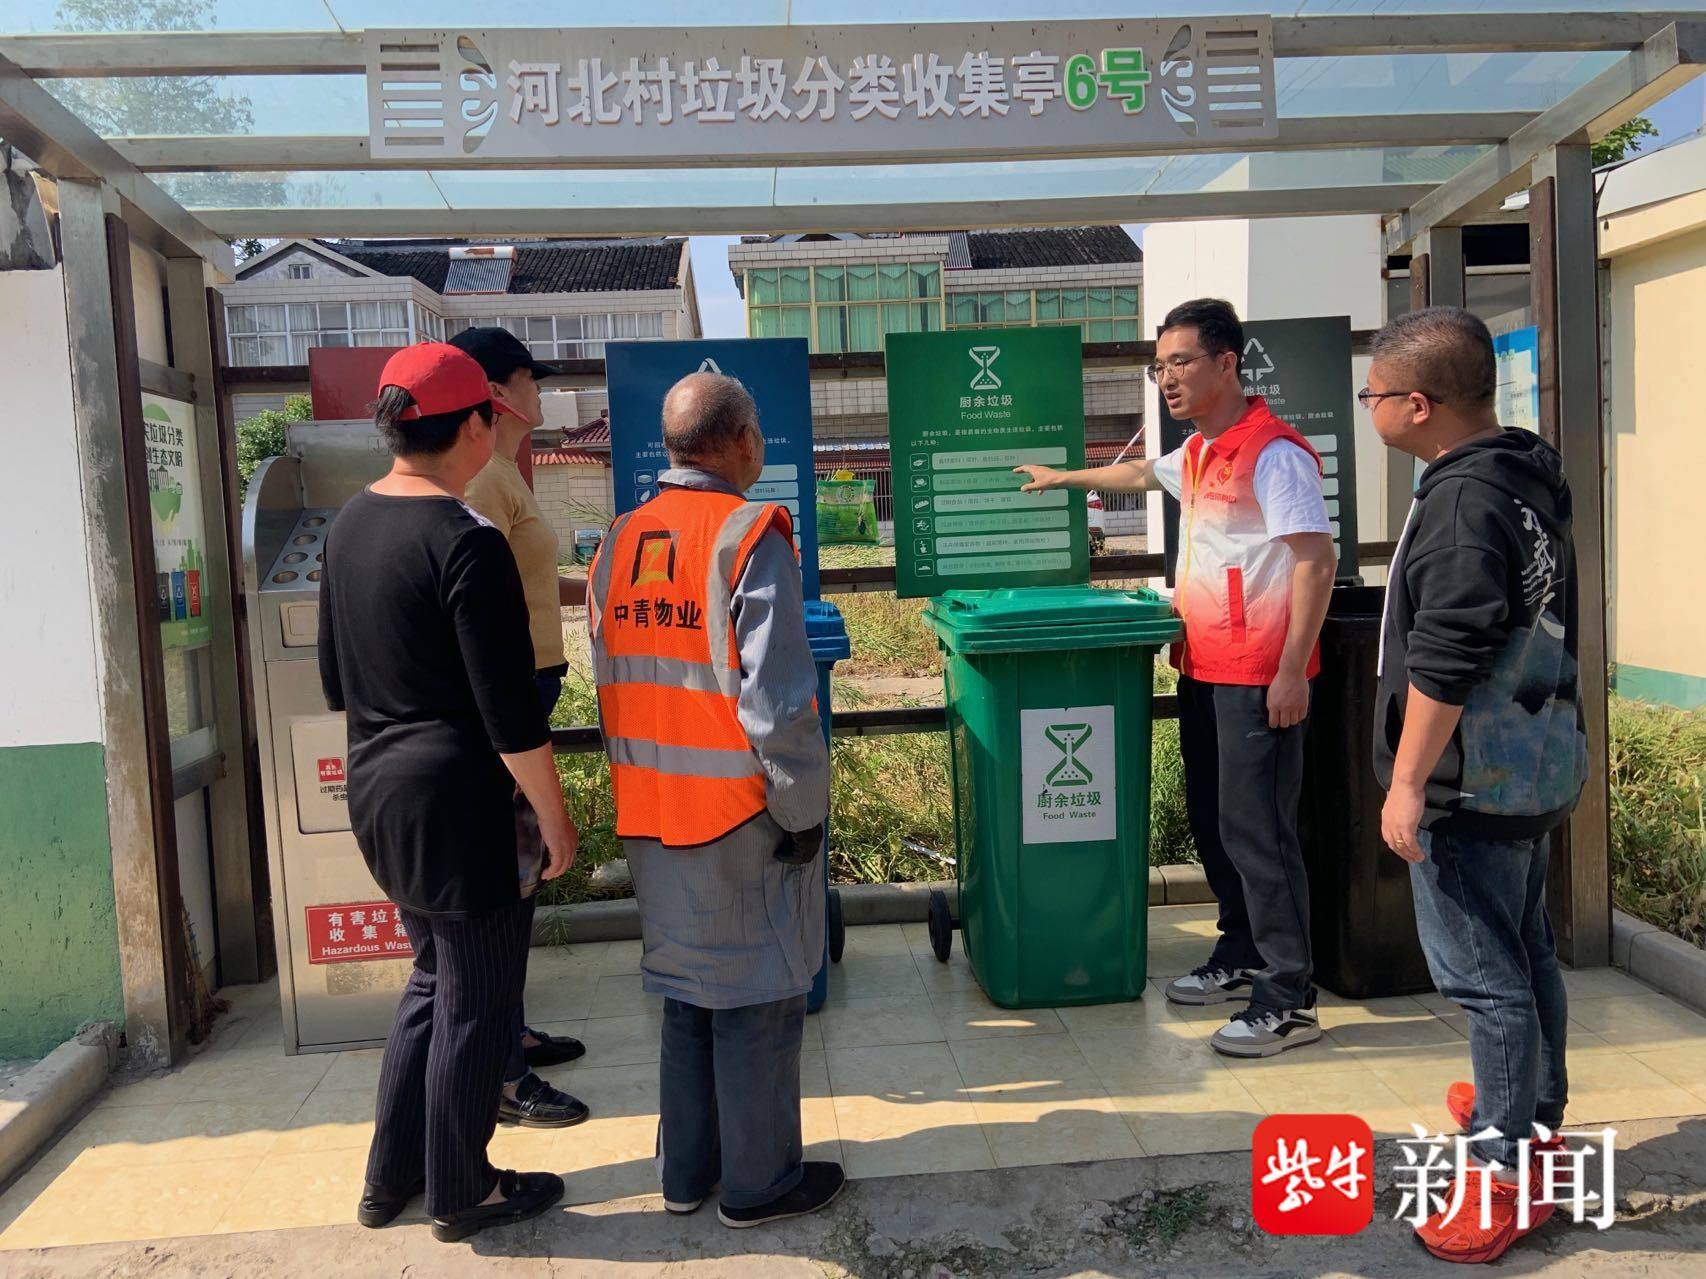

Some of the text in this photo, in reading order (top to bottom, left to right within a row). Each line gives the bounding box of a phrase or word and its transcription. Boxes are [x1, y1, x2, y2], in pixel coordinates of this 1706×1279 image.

[508, 47, 1152, 126] 河北村垃圾分类收集亭6号
[959, 394, 1013, 408] 厨余垃圾
[961, 409, 1012, 420] Food Waste
[614, 597, 702, 630] 中青物业
[1037, 791, 1102, 809] 厨余垃圾
[1043, 811, 1097, 821] Food Waste
[322, 943, 380, 956] Hazardous
